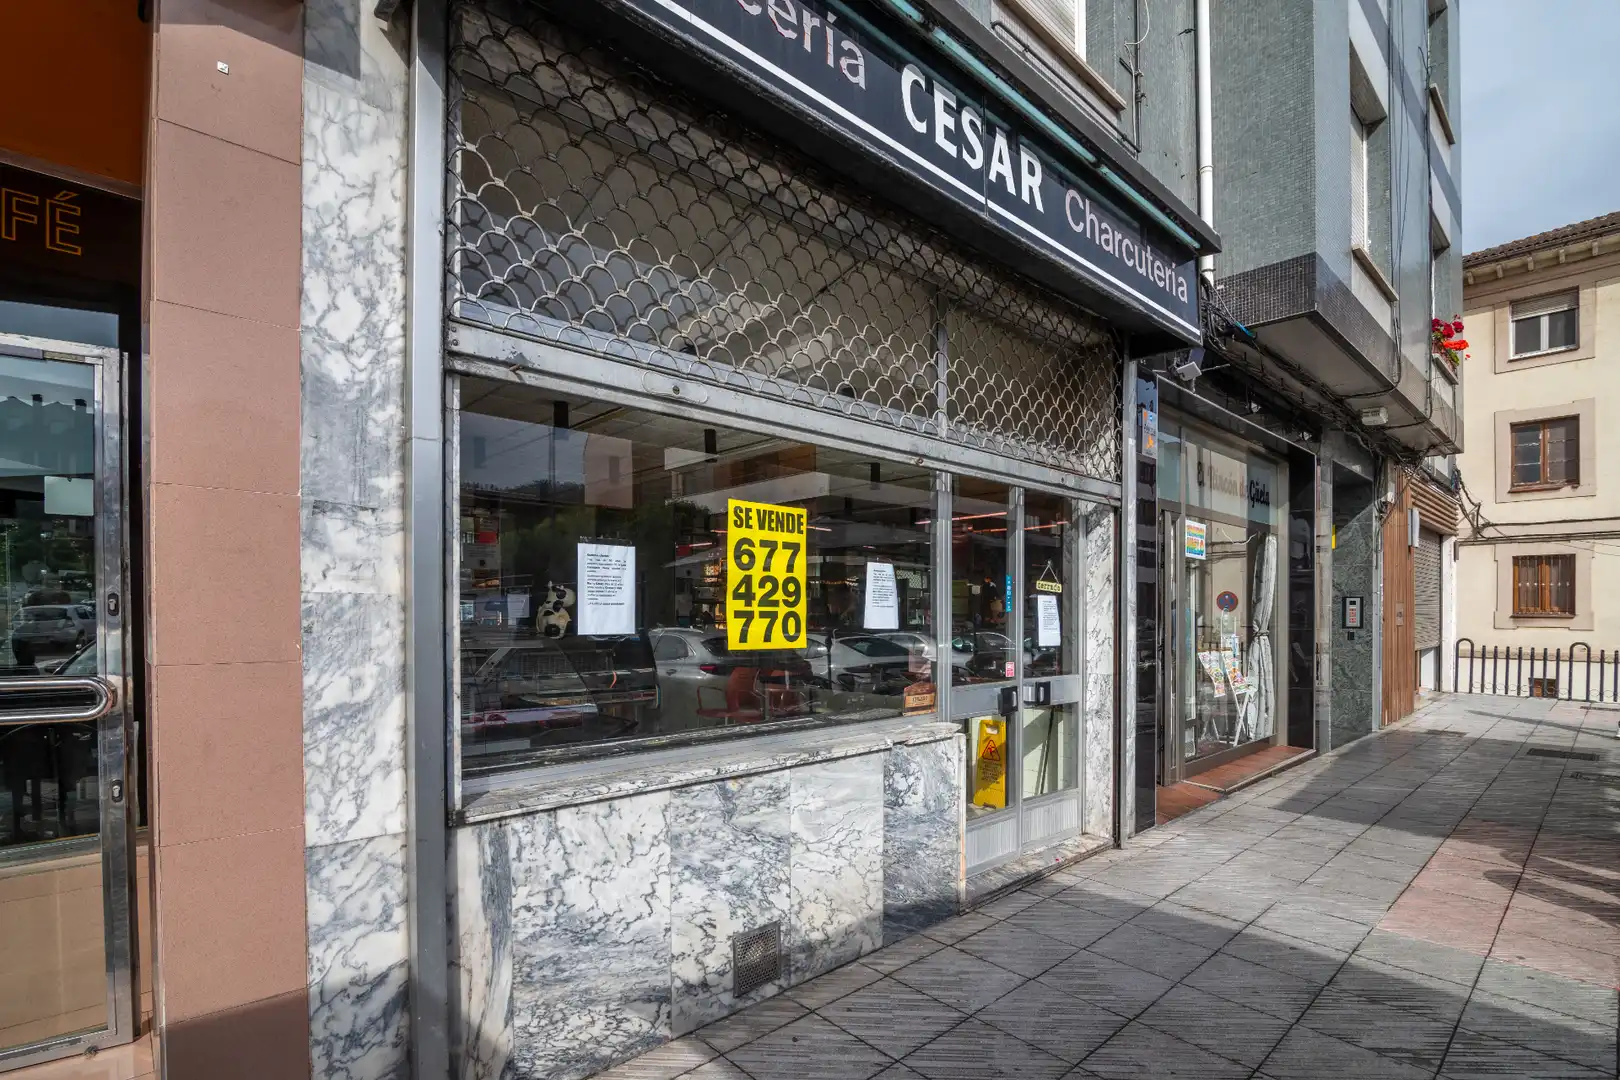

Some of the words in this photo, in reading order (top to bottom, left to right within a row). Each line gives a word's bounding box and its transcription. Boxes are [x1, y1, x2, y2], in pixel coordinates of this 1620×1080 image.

[736, 0, 866, 90] ería
[901, 63, 1044, 214] CESAR
[1065, 189, 1188, 303] Charcutería
[2, 187, 82, 256] FÉ
[733, 505, 753, 529] SE
[756, 508, 804, 535] VENDE
[733, 537, 801, 574] 677
[732, 574, 802, 609] 429
[733, 609, 801, 643] 770
